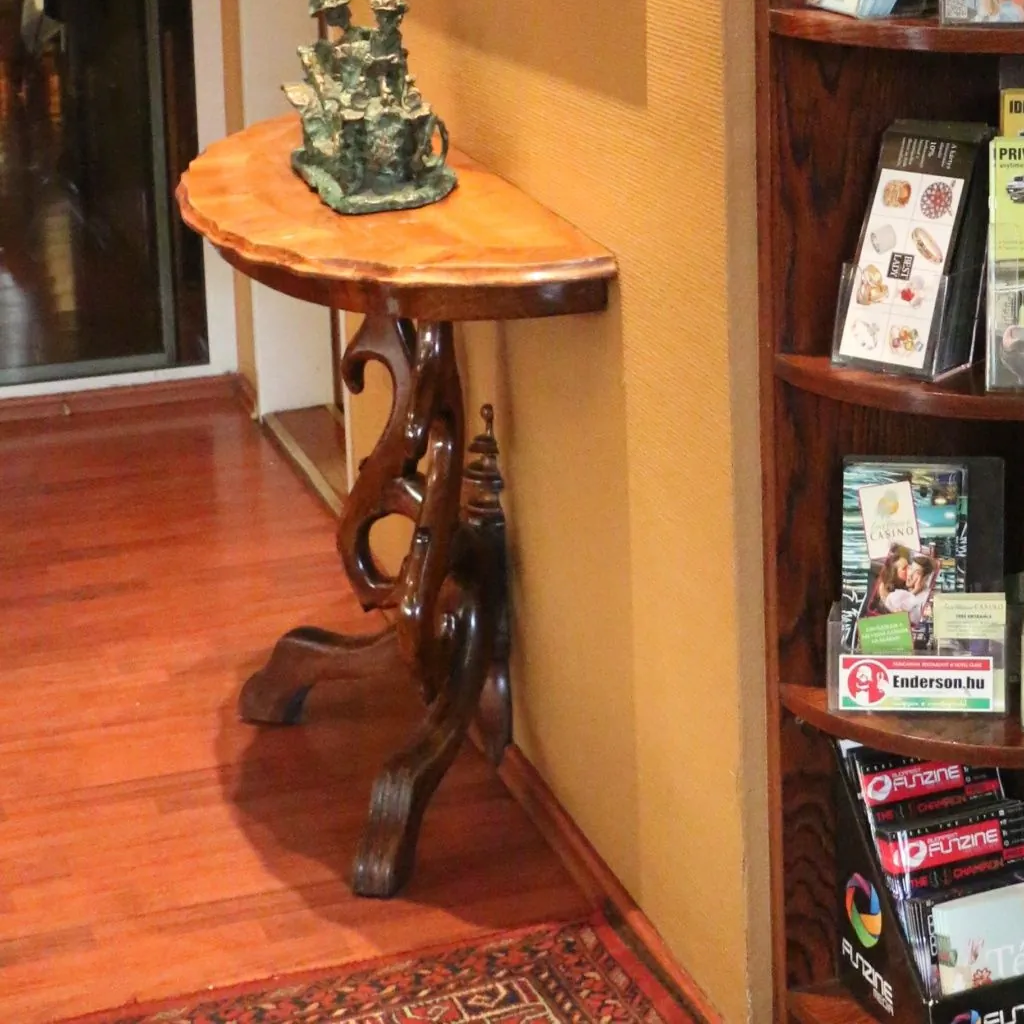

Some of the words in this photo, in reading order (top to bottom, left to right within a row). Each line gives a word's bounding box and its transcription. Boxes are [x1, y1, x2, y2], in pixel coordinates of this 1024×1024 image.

[890, 254, 901, 279] LADY
[902, 255, 913, 280] BEST
[870, 527, 914, 541] CASINO
[893, 675, 985, 690] Enderson.hu
[893, 765, 960, 792] FUNZINE
[917, 795, 968, 812] CHAMPION
[876, 809, 895, 822] THE
[929, 828, 998, 858] FUNZINE
[953, 858, 1004, 880] CHAMPION
[911, 876, 929, 888] THE
[842, 937, 894, 1000] FUNZINE
[873, 988, 895, 1017] MEDIA
